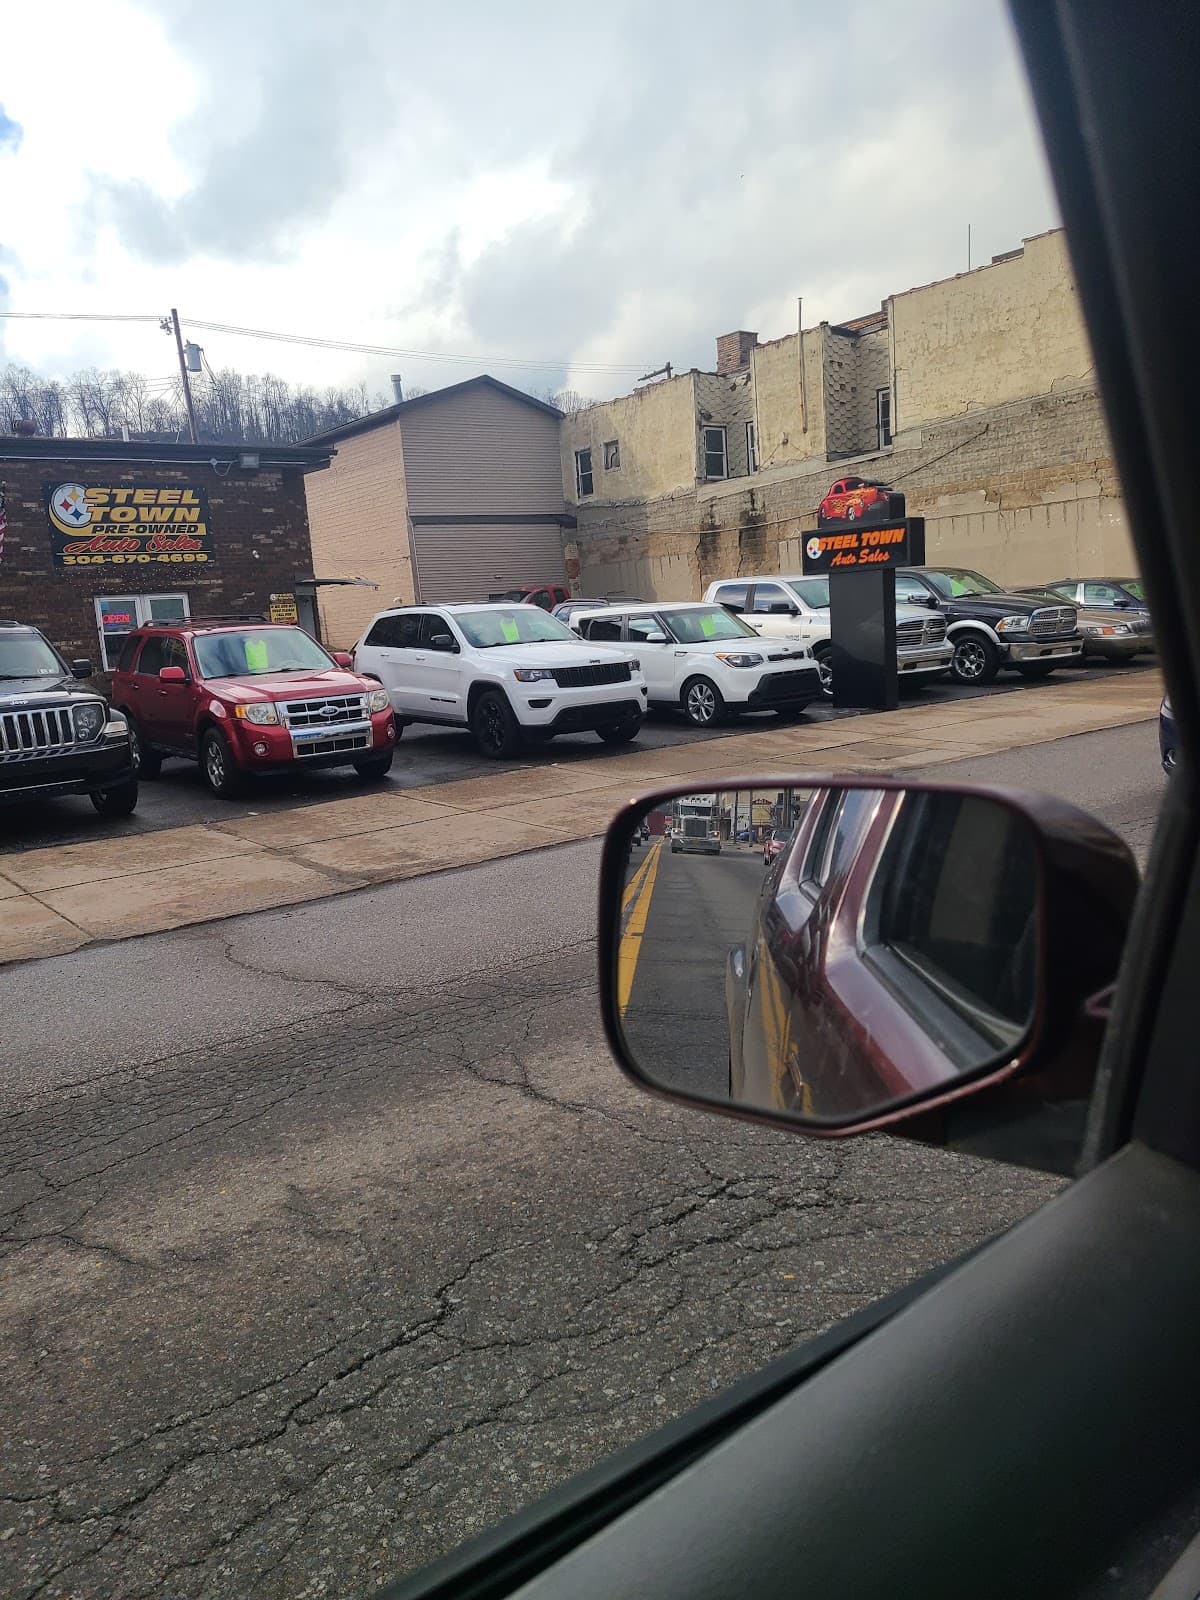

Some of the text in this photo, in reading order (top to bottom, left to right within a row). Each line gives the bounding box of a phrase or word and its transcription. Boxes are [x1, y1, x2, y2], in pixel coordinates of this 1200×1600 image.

[83, 488, 200, 505] STEEL
[86, 506, 201, 523] TOWN
[91, 524, 199, 534] PRE-OWNED
[63, 533, 203, 554] Auto Sales
[817, 528, 906, 551] STEEL TOWN
[830, 548, 891, 567] Auto Sales
[102, 613, 131, 625] OPEN
